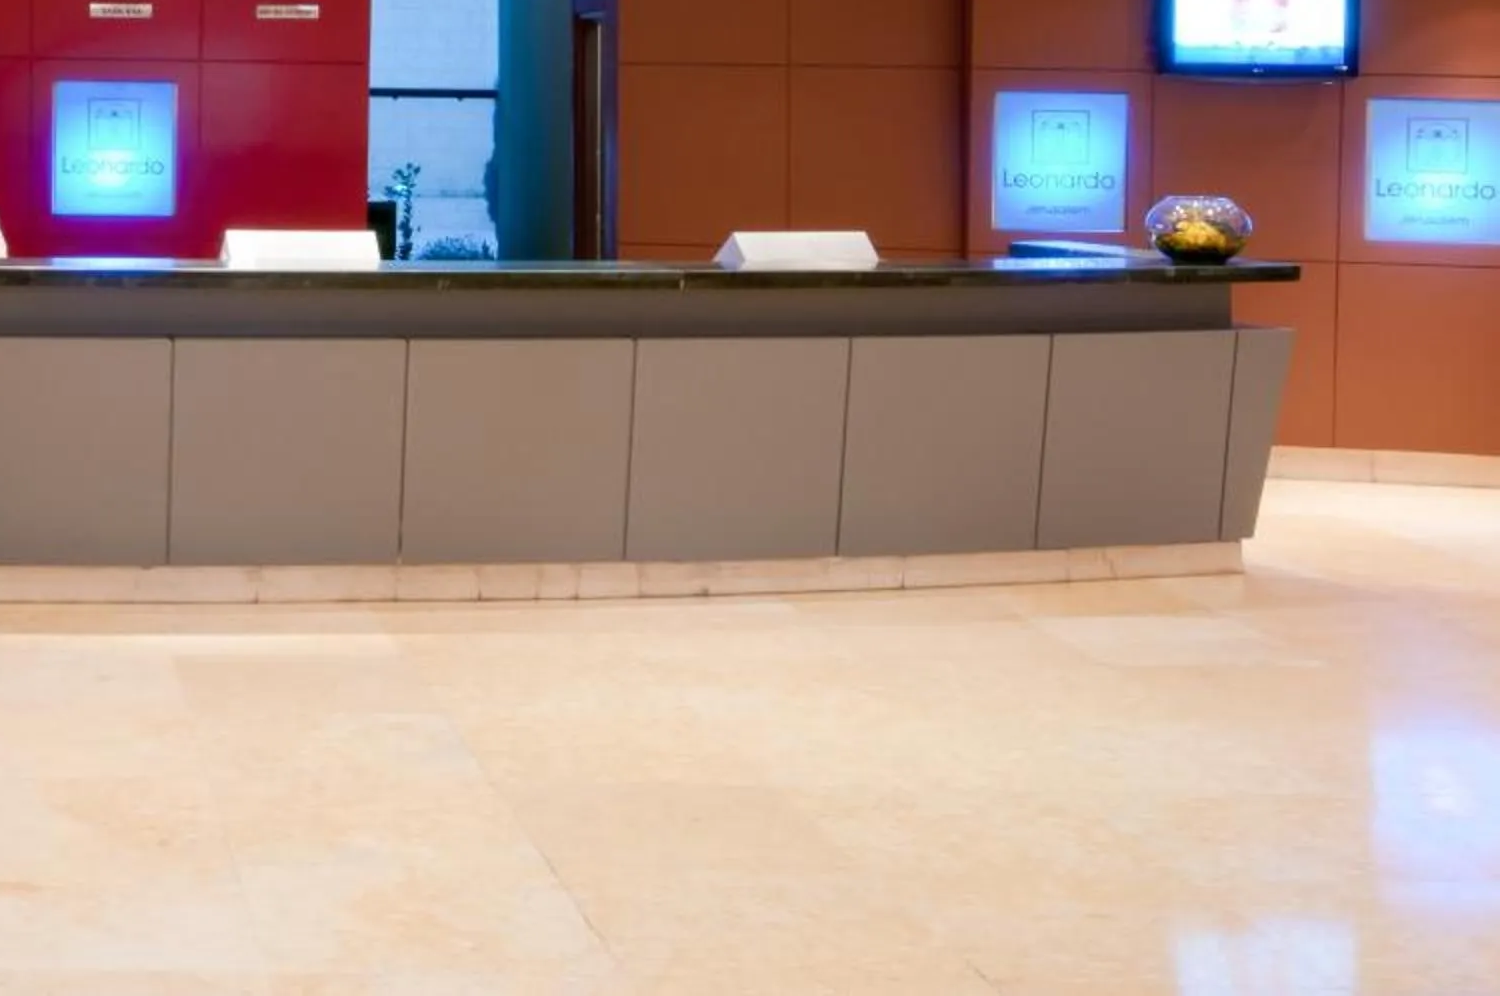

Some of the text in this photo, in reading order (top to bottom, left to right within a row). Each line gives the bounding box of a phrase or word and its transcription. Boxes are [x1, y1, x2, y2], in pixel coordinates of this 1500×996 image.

[61, 155, 165, 176] Leonardo
[1002, 167, 1116, 190] Leonardo
[1375, 178, 1497, 201] Leonardo
